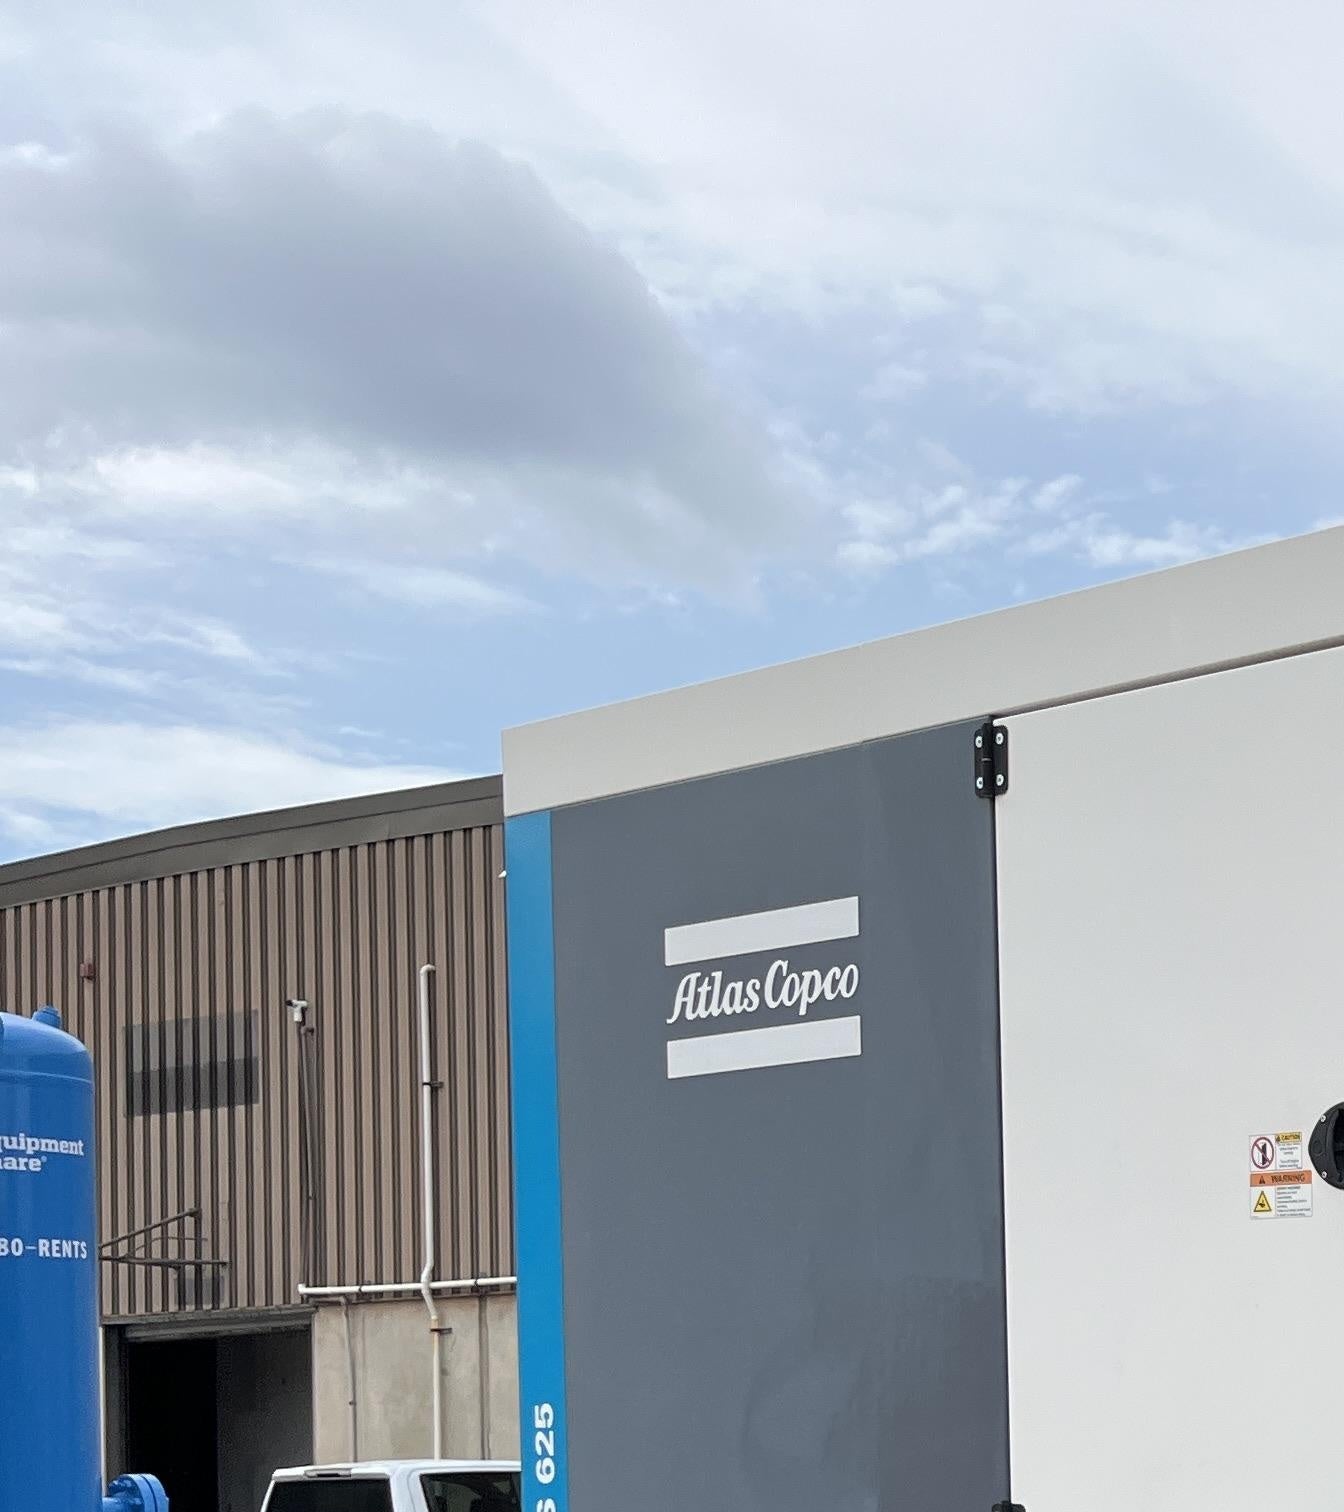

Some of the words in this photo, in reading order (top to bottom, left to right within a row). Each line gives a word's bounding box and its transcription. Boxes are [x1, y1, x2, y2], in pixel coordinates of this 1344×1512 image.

[666, 970, 760, 1024] Atlas
[765, 959, 859, 1016] Copco
[0, 1133, 84, 1156] uipment
[534, 1403, 555, 1484] 625
